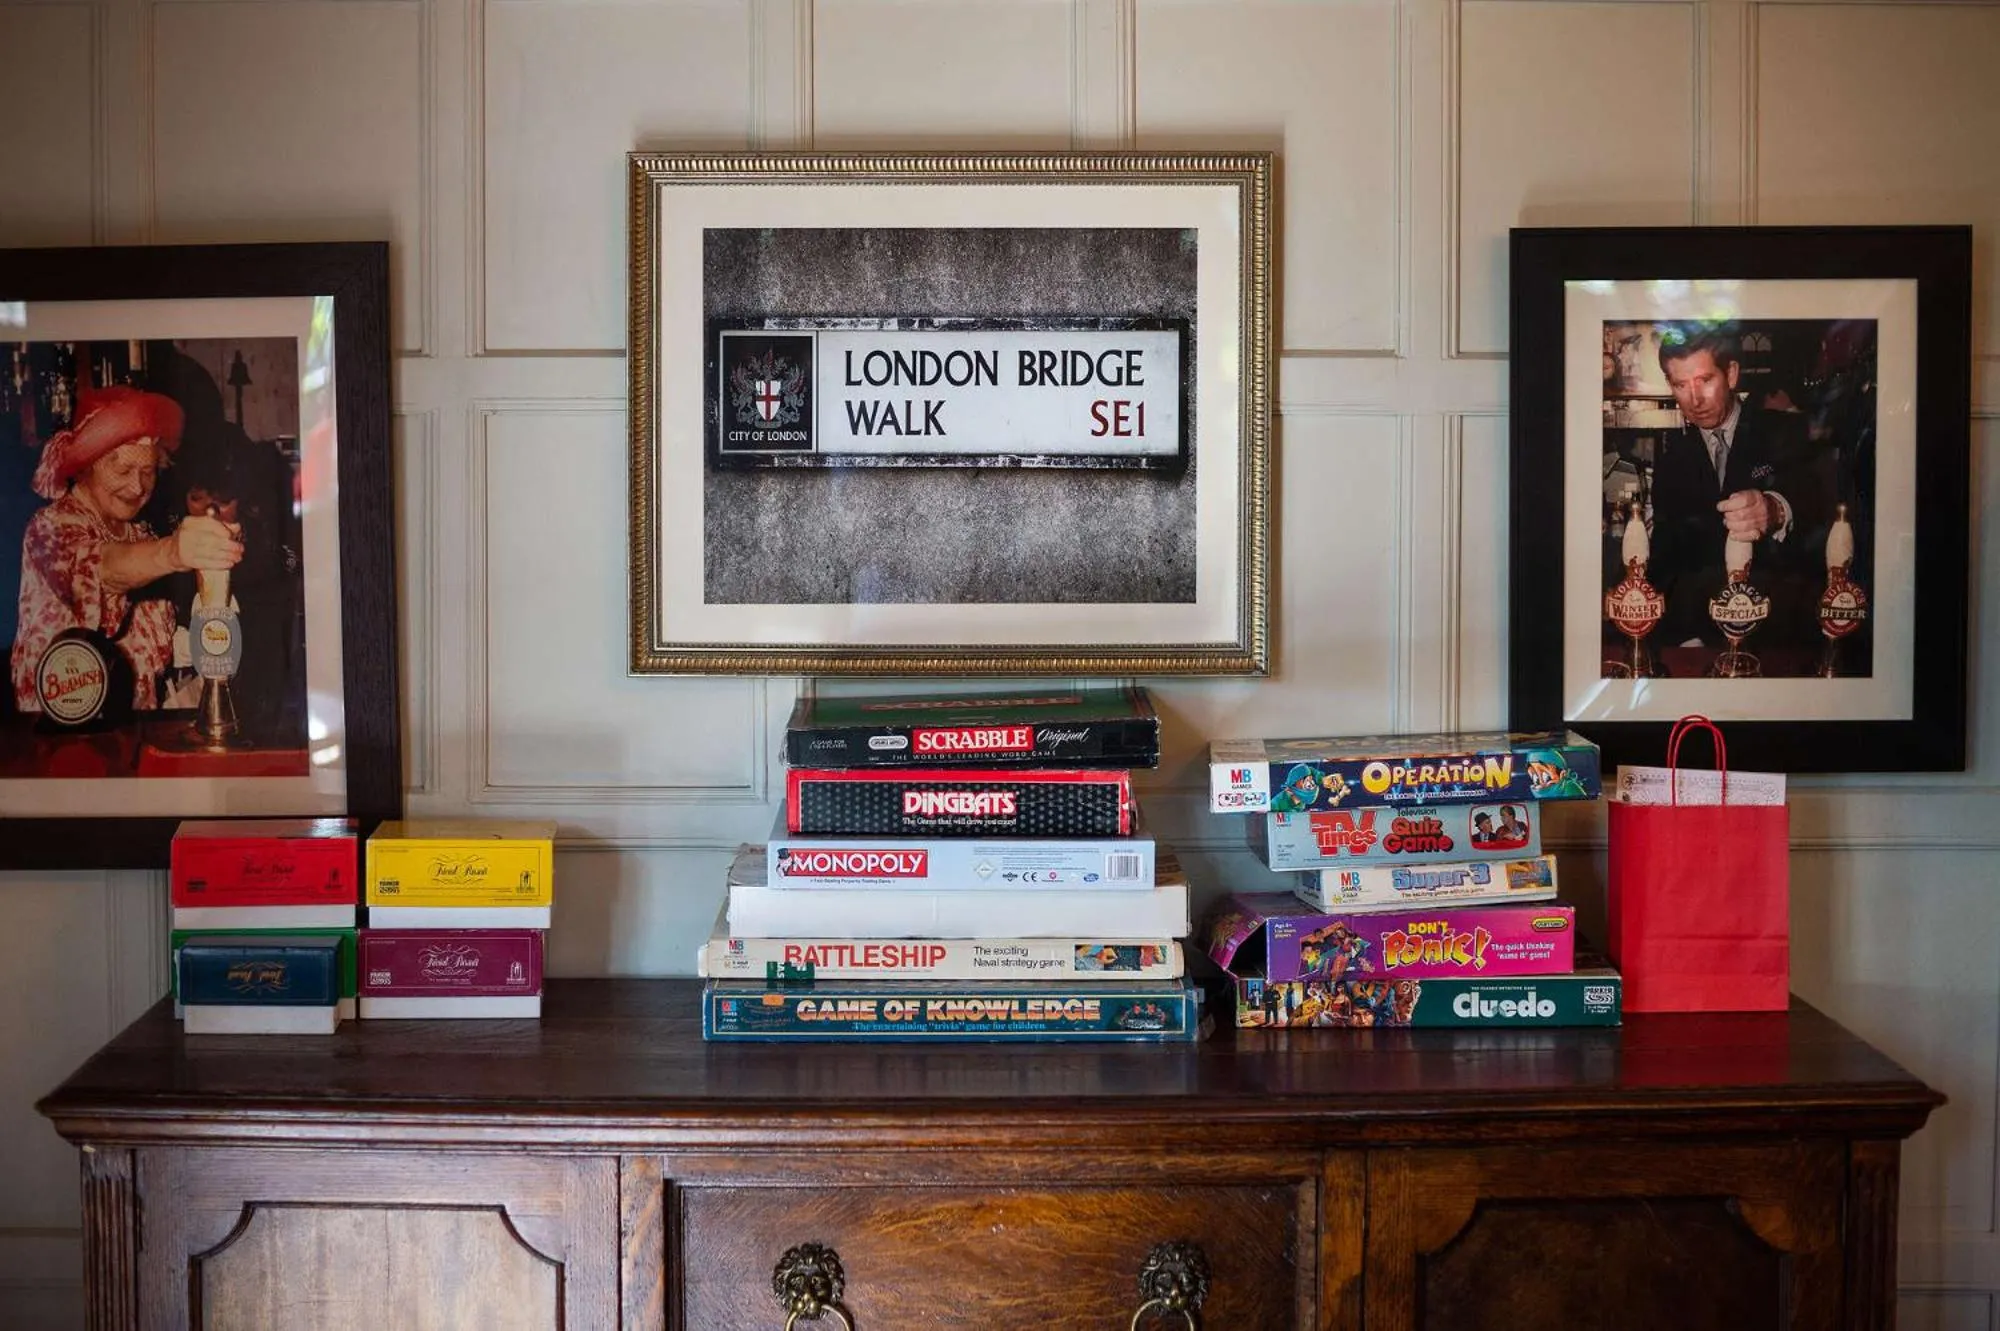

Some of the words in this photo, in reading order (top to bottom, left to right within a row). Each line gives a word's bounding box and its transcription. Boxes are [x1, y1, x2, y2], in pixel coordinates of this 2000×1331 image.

[845, 350, 998, 386] LONDON
[1018, 350, 1144, 386] BRIDGE
[845, 400, 946, 435] WALK
[1090, 400, 1145, 436] SE1
[728, 430, 750, 441] CITY
[752, 431, 765, 441] OF
[767, 430, 807, 441] LONDON
[1717, 583, 1763, 604] YOUNG'S
[1715, 607, 1766, 619] SPECIAL
[1821, 608, 1867, 619] BITTER
[45, 669, 101, 700] BEAMISH
[918, 729, 1028, 750] SCRABBLE
[1036, 727, 1091, 748] Original
[892, 753, 908, 761] THE
[1230, 769, 1253, 783] MB
[903, 817, 914, 825] The
[938, 817, 952, 825] that
[1391, 816, 1443, 837] Quiz
[1310, 811, 1377, 857] TV
[1312, 825, 1379, 847] Times
[1383, 834, 1454, 855] Game
[793, 853, 923, 873] MONOPOLY
[1340, 871, 1361, 885] MB
[1392, 868, 1469, 891] Super
[1469, 863, 1492, 884] 3
[1408, 921, 1449, 935] DON'T
[729, 940, 744, 950] MB
[974, 947, 992, 956] The
[993, 946, 1029, 958] exciting
[1491, 943, 1504, 951] The
[1505, 942, 1524, 952] quick
[784, 945, 947, 967] BATTLESHIP
[974, 958, 1000, 967] Naval
[1001, 958, 1038, 969] strategy
[1040, 960, 1066, 969] game
[796, 1000, 878, 1021] GAME
[883, 1000, 921, 1021] OF
[926, 999, 1101, 1021] KNOWLEDGE
[1453, 991, 1557, 1019] Cluedo
[852, 1021, 872, 1031] The
[872, 1022, 928, 1033] entertaining
[965, 1023, 991, 1033] game
[992, 1021, 1008, 1031] for
